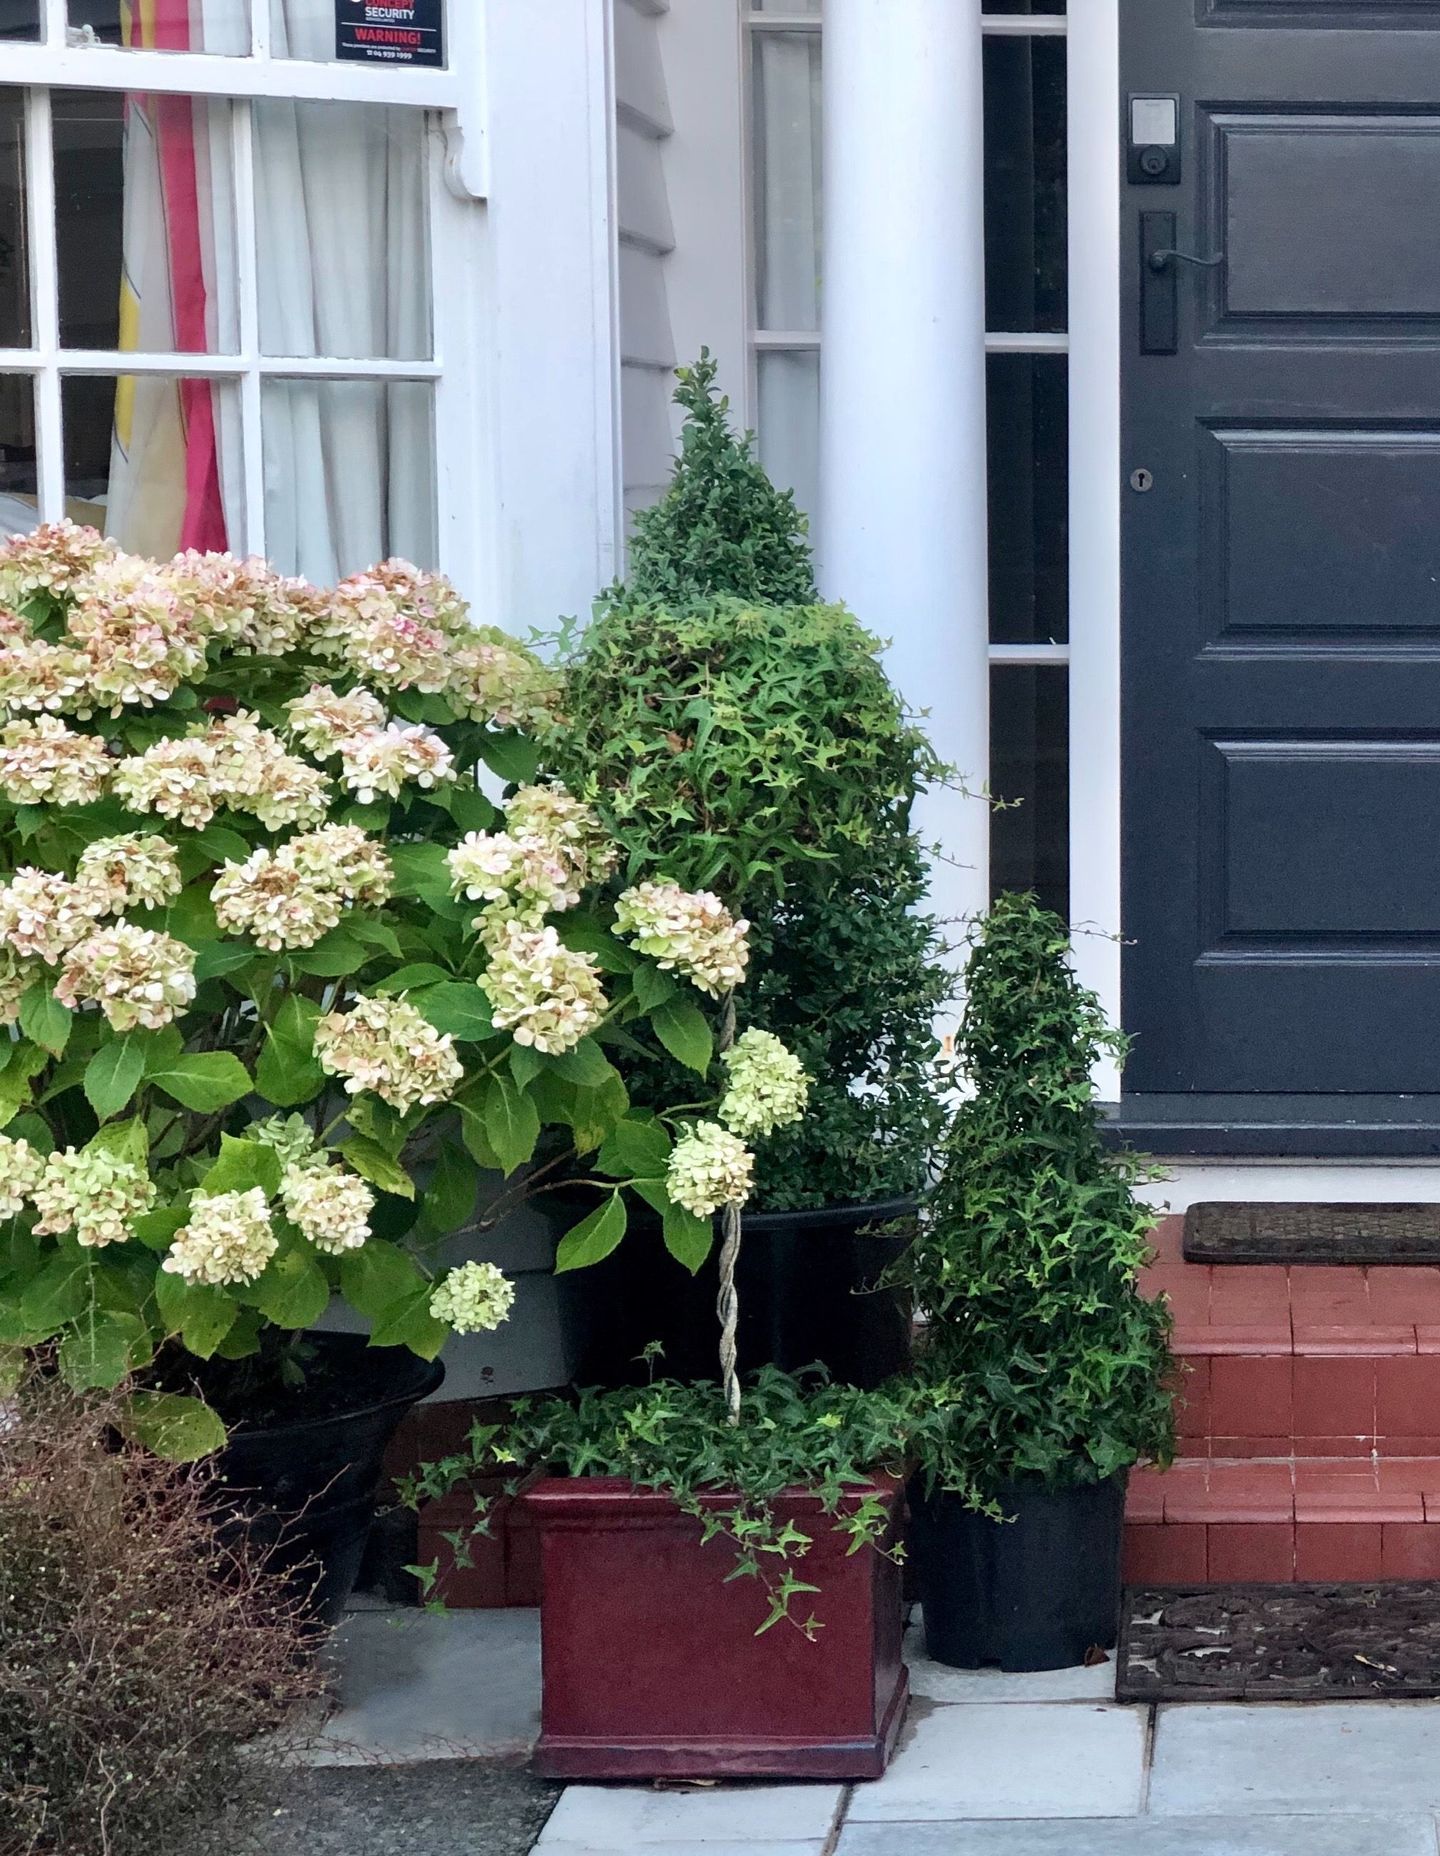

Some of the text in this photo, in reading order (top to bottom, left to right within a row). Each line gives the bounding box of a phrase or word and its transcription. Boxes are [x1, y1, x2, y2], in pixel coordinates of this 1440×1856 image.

[366, 0, 414, 9] CONCEPT
[365, 7, 414, 19] SECURITY
[355, 28, 421, 44] WARNING!
